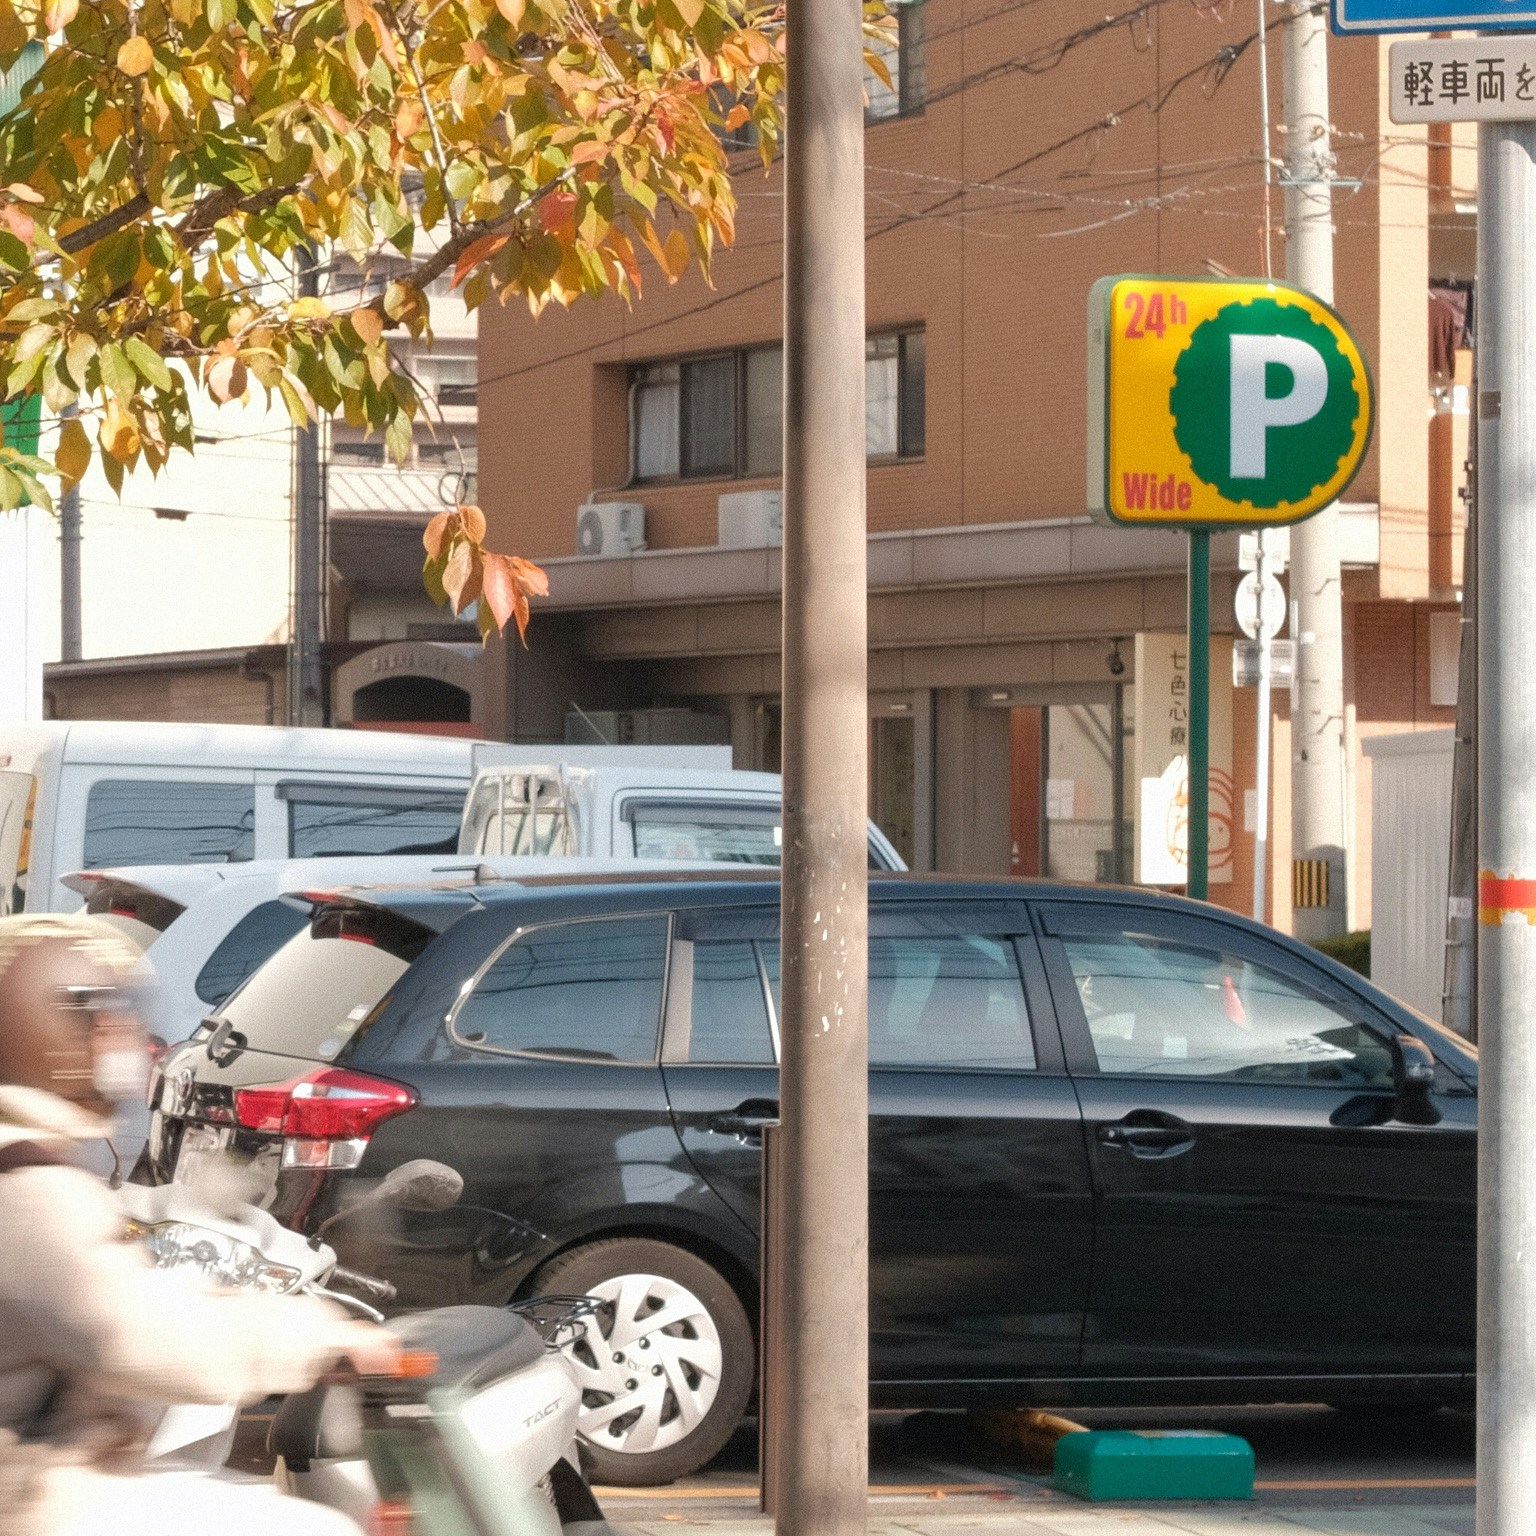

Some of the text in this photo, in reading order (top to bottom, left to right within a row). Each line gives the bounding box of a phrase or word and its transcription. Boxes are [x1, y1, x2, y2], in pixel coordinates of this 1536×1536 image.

[1404, 58, 1536, 106] 軽車両を
[1124, 292, 1188, 340] 24h
[1229, 333, 1329, 479] P
[1122, 472, 1193, 511] Wide
[522, 1396, 562, 1428] TACT
